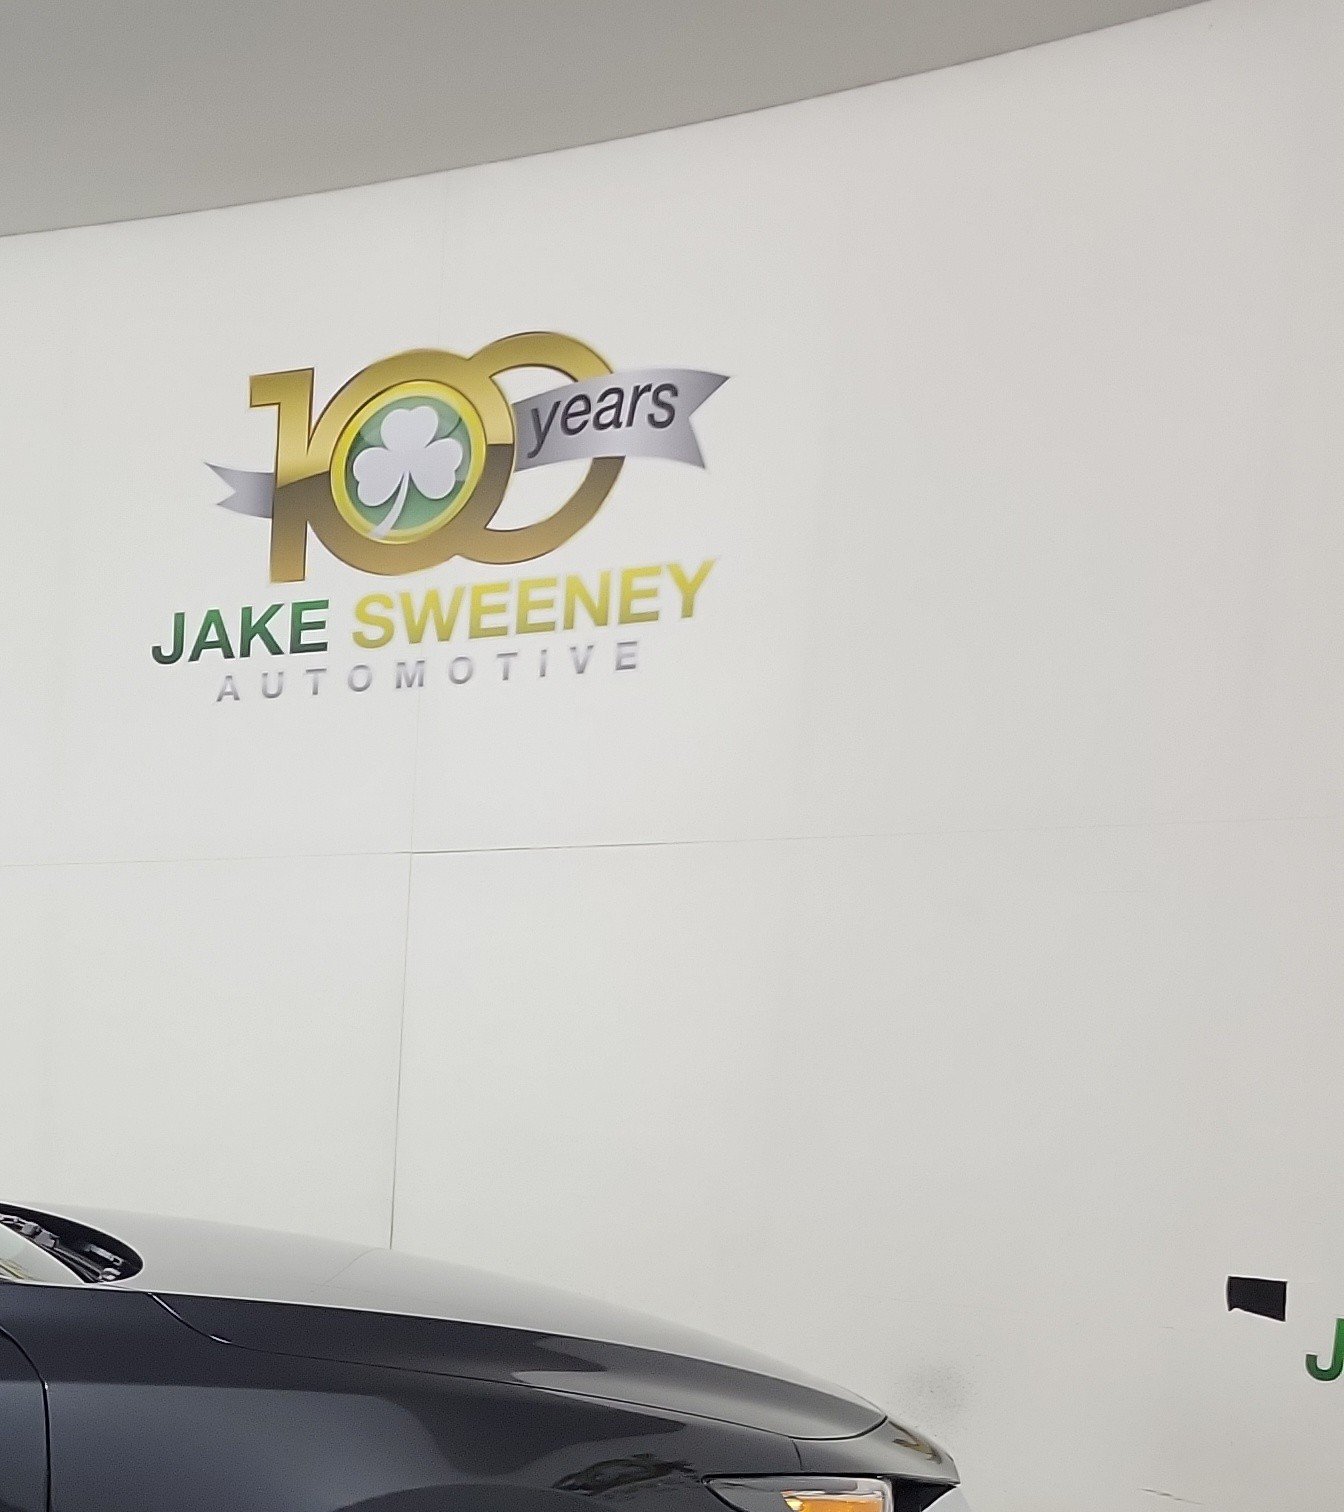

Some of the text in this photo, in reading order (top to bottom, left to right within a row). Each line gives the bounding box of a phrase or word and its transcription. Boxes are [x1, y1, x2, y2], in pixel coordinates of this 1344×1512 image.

[249, 331, 679, 583] 100 years
[151, 558, 717, 666] JAKE SWEENEY
[215, 640, 642, 703] AUTOMOTIVE
